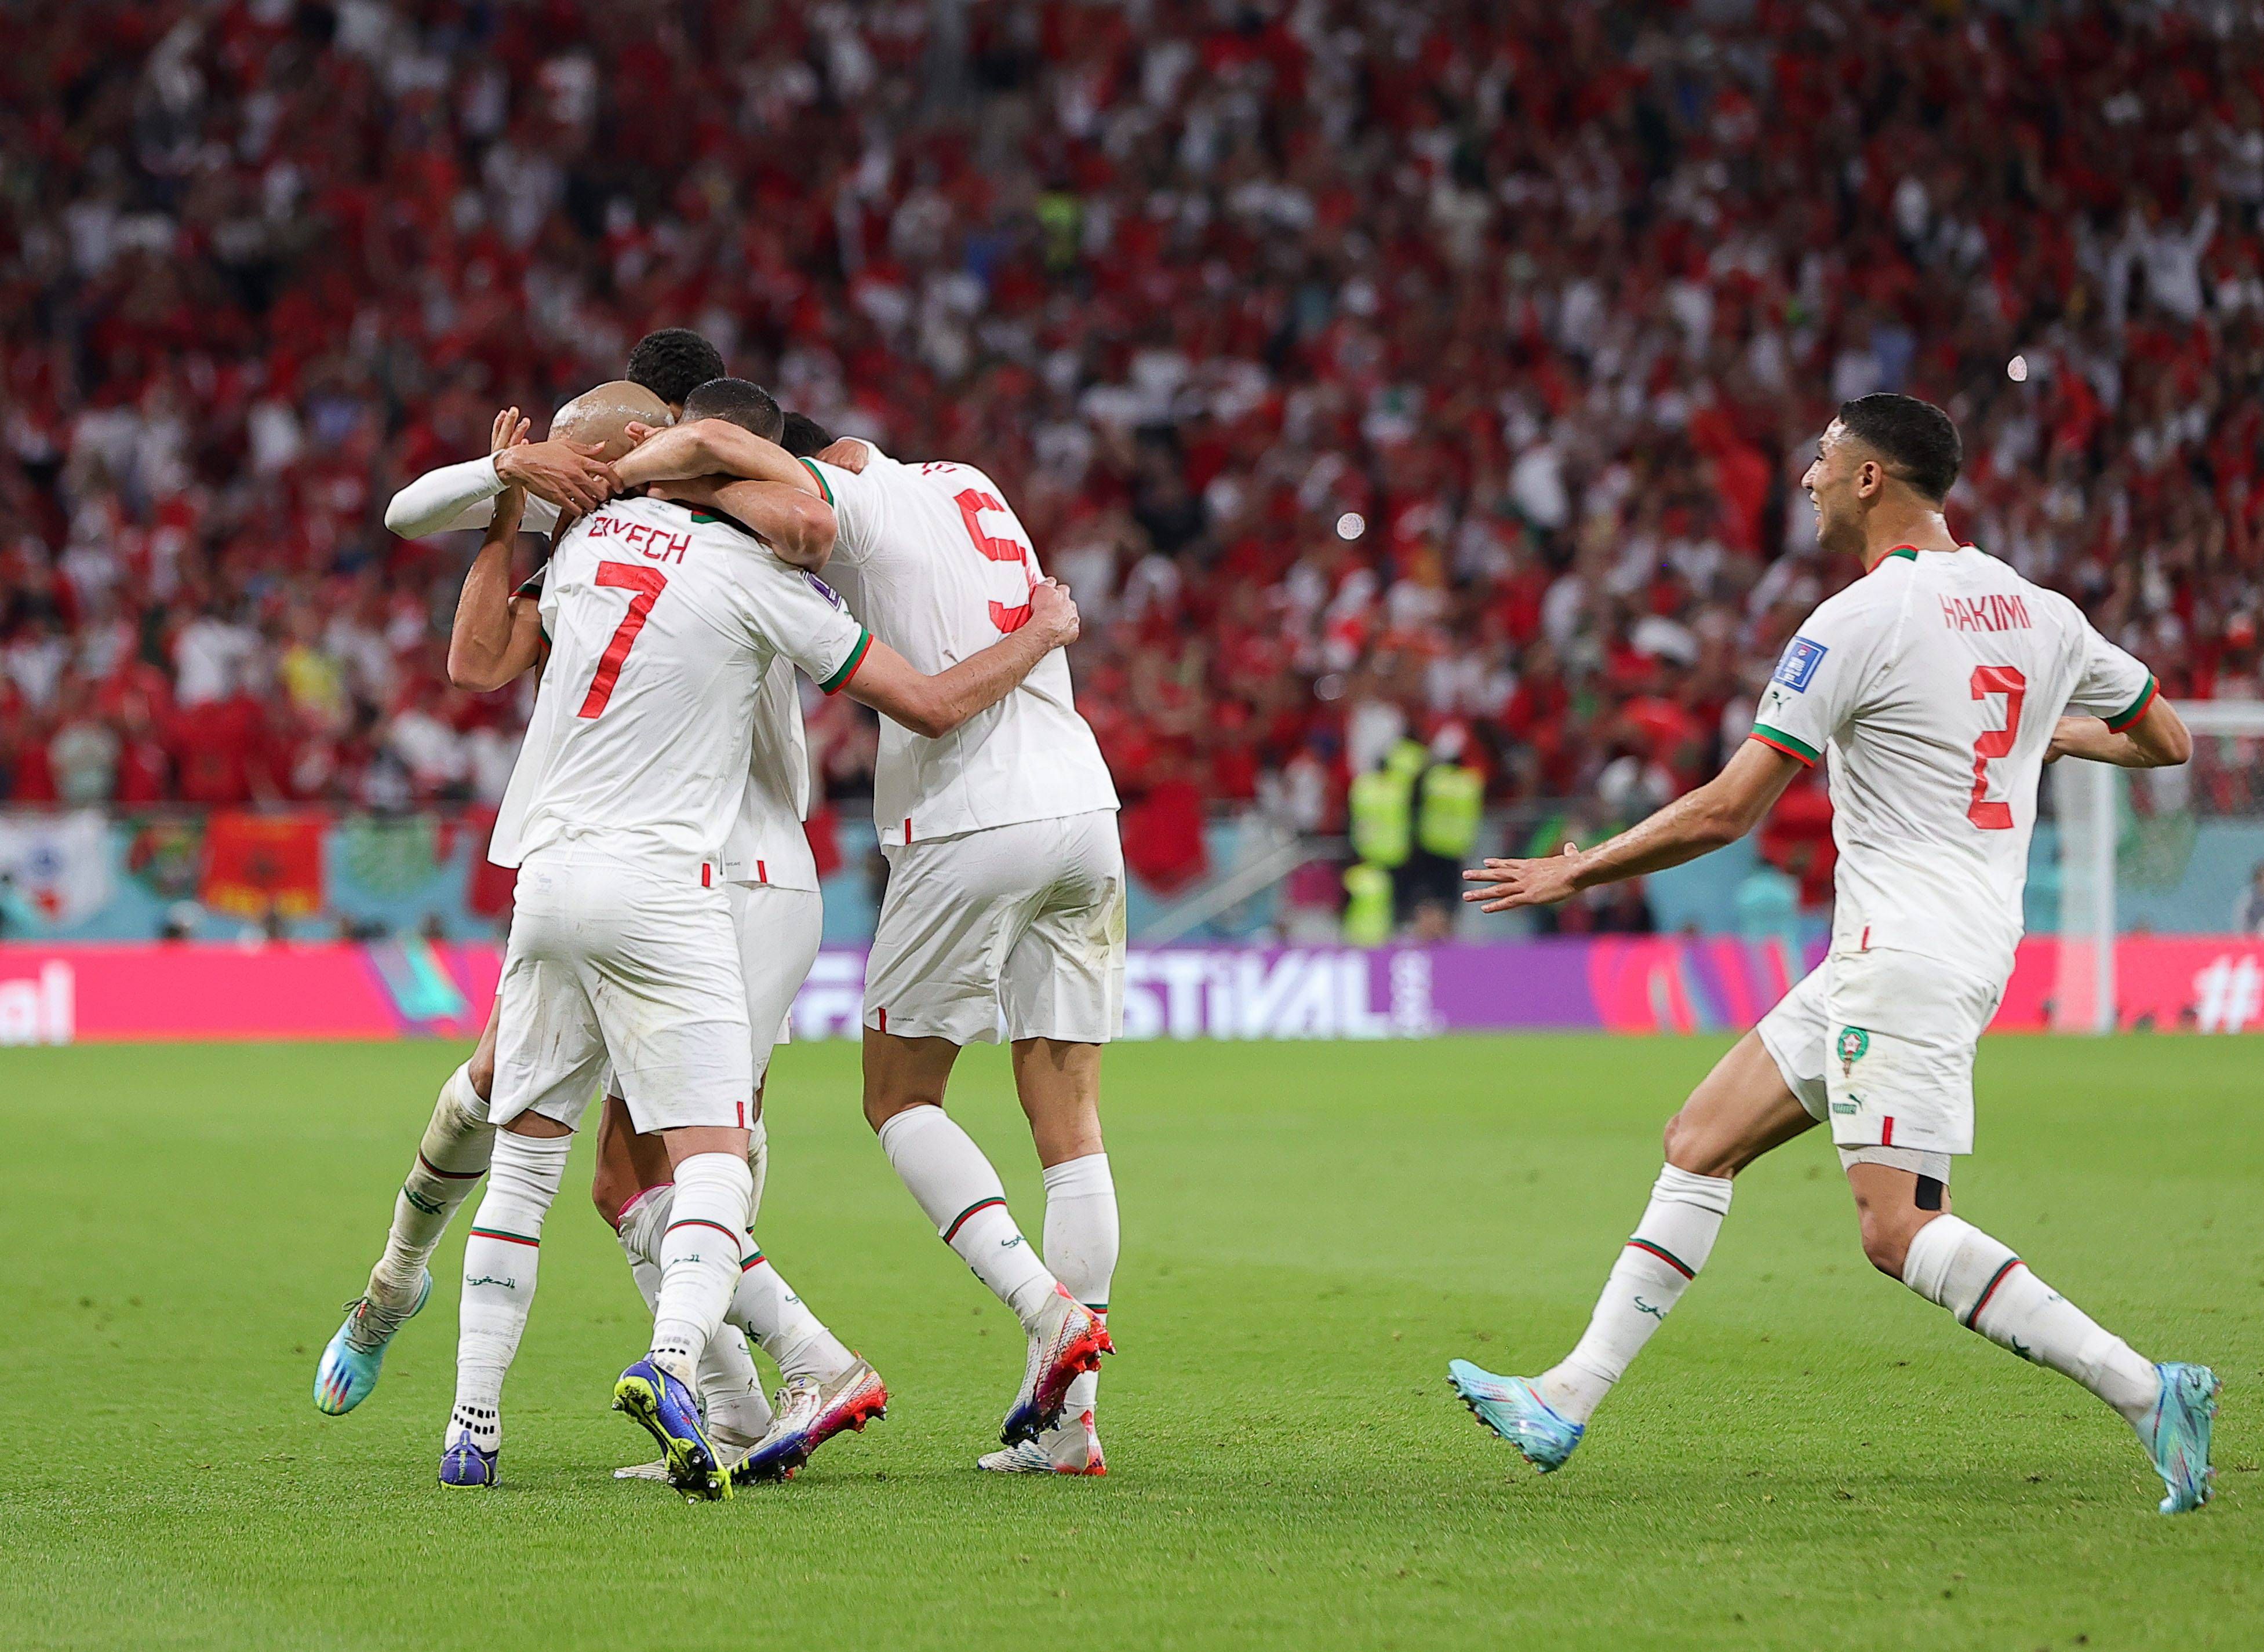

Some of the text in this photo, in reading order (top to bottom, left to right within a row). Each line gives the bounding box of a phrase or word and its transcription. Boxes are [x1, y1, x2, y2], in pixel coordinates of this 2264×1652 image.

[952, 488, 1038, 634] 5
[1937, 593, 2032, 632] HAKIMI
[576, 560, 668, 719] 7
[1967, 665, 2026, 830] 2
